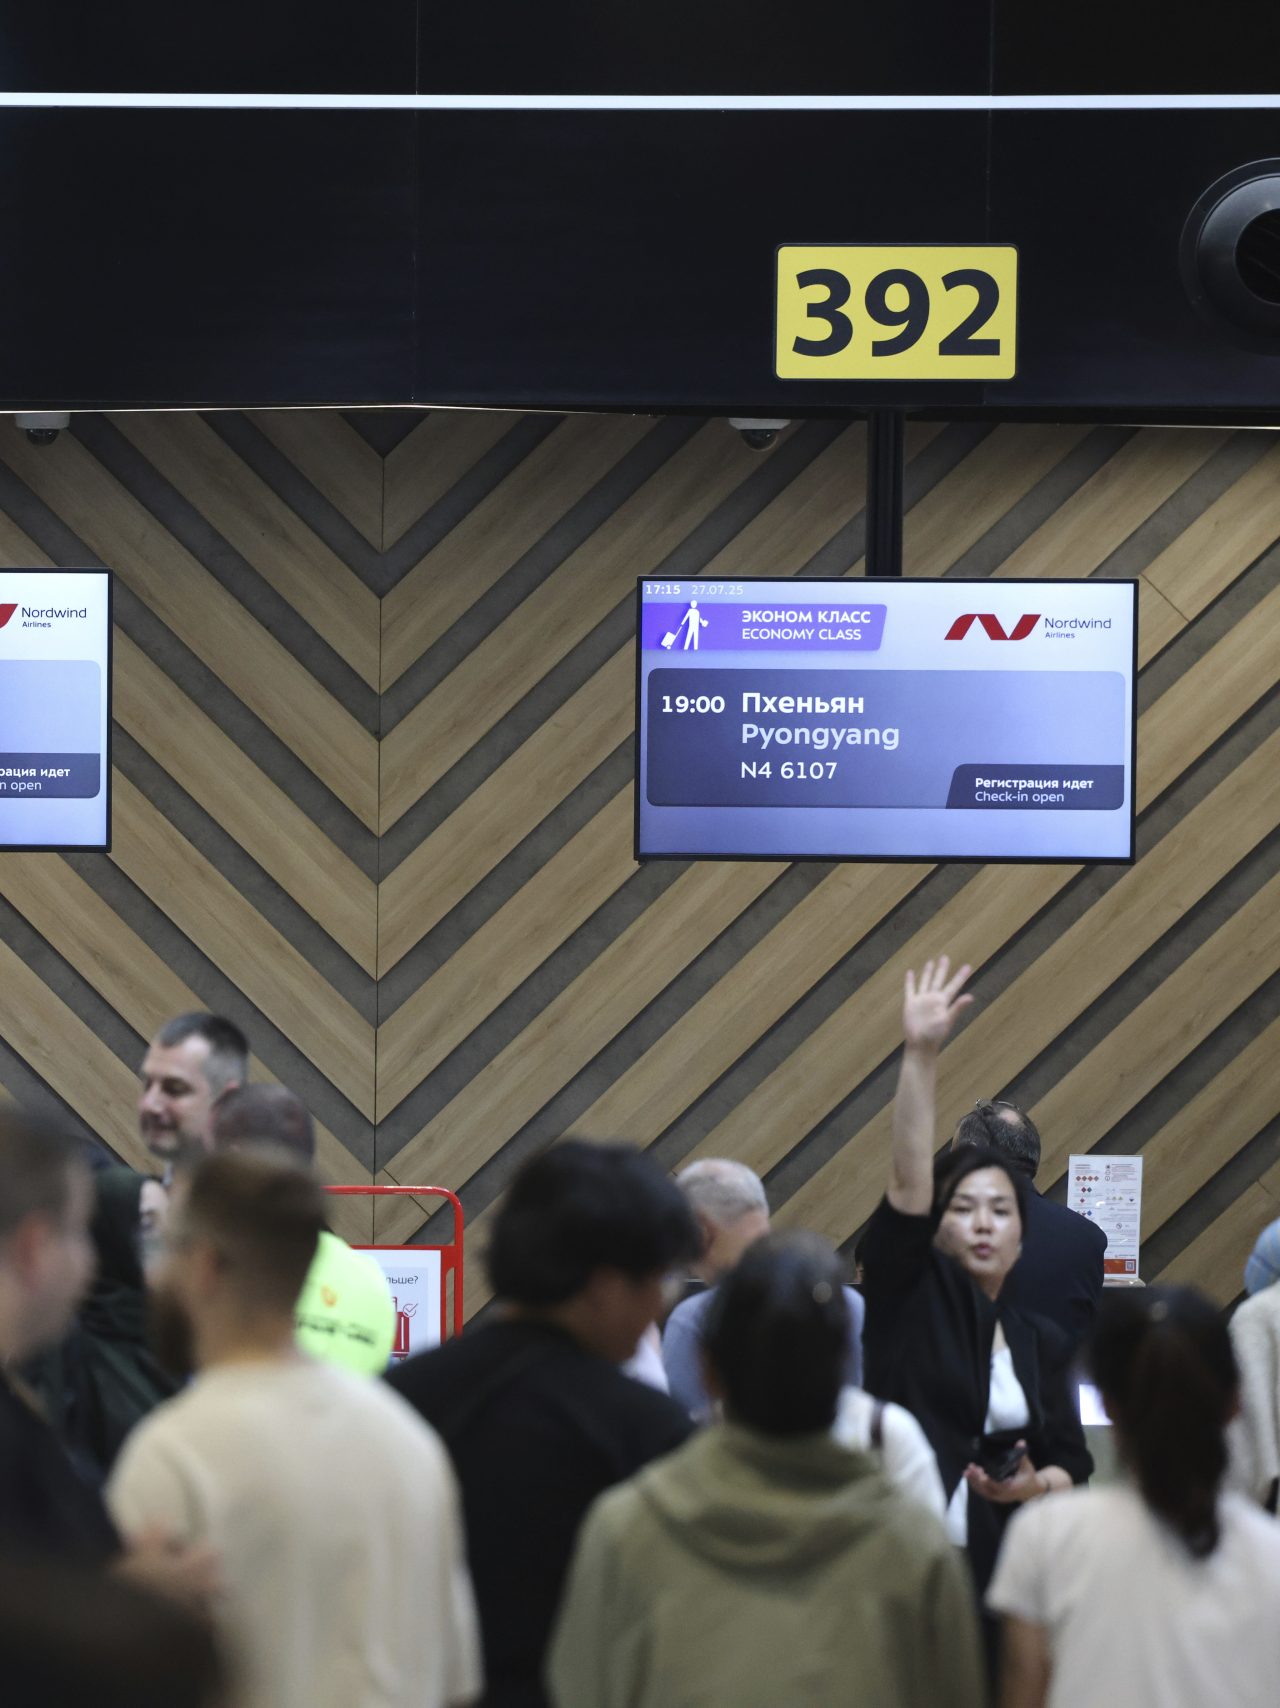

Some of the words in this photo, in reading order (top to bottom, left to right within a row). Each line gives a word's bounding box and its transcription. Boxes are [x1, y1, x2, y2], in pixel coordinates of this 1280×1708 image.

[792, 269, 1000, 357] 392
[646, 584, 681, 595] 17:15
[691, 584, 745, 597] 27.07.25
[21, 607, 87, 619] Nordwind
[741, 610, 813, 623] ЭКОНОМ
[817, 610, 871, 624] КЛАСС
[21, 620, 52, 628] Airlines
[1044, 617, 1112, 629] Nordwind
[742, 628, 815, 640] ECONOMY
[818, 628, 862, 641] CLASS
[1044, 631, 1076, 639] Airlines
[662, 695, 726, 714] 19:00
[742, 692, 865, 714] Пхеньян
[742, 723, 900, 751] Pyongyang
[40, 768, 71, 779] идет
[741, 761, 773, 779] N4
[780, 761, 838, 780] 6107
[10, 781, 42, 793] open
[975, 777, 1059, 791] Регистрация
[1062, 779, 1095, 791] идет
[974, 790, 1029, 802] Check-in
[1031, 793, 1065, 805] open
